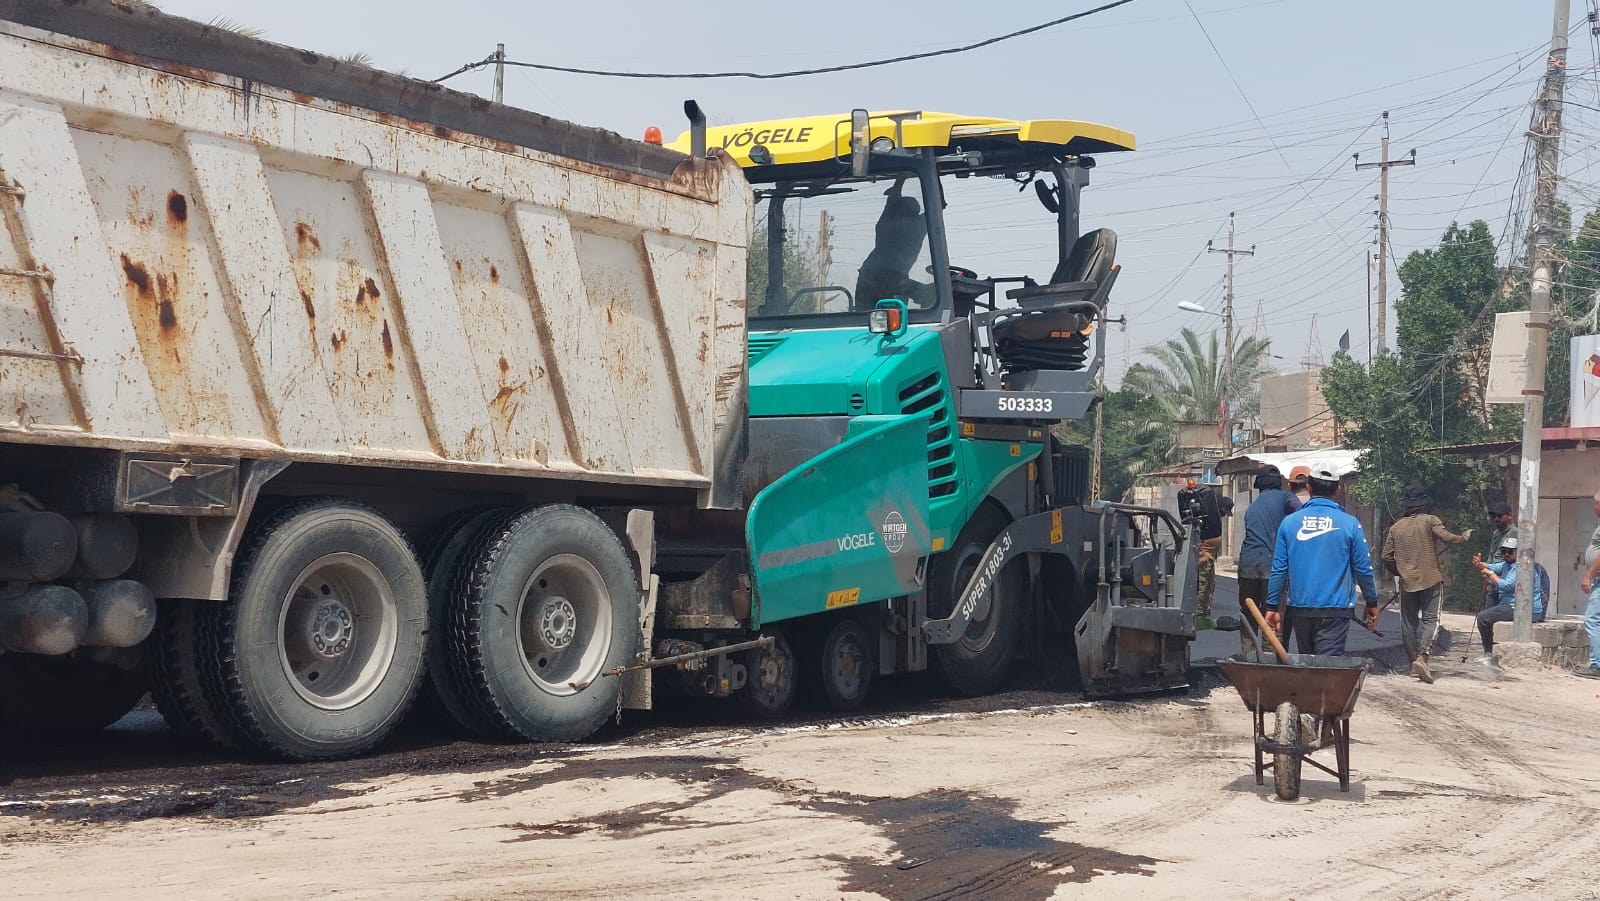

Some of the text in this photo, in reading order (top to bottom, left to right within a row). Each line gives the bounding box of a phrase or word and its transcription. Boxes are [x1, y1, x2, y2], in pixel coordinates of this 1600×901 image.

[722, 127, 813, 149] VÖGELE
[998, 397, 1053, 413] 503333
[882, 523, 907, 533] WIRTGEN
[1302, 516, 1333, 530] 运动
[837, 532, 875, 551] VÖGELE
[883, 534, 905, 542] GROUP
[962, 531, 1012, 621] SUPER 1803-3i
